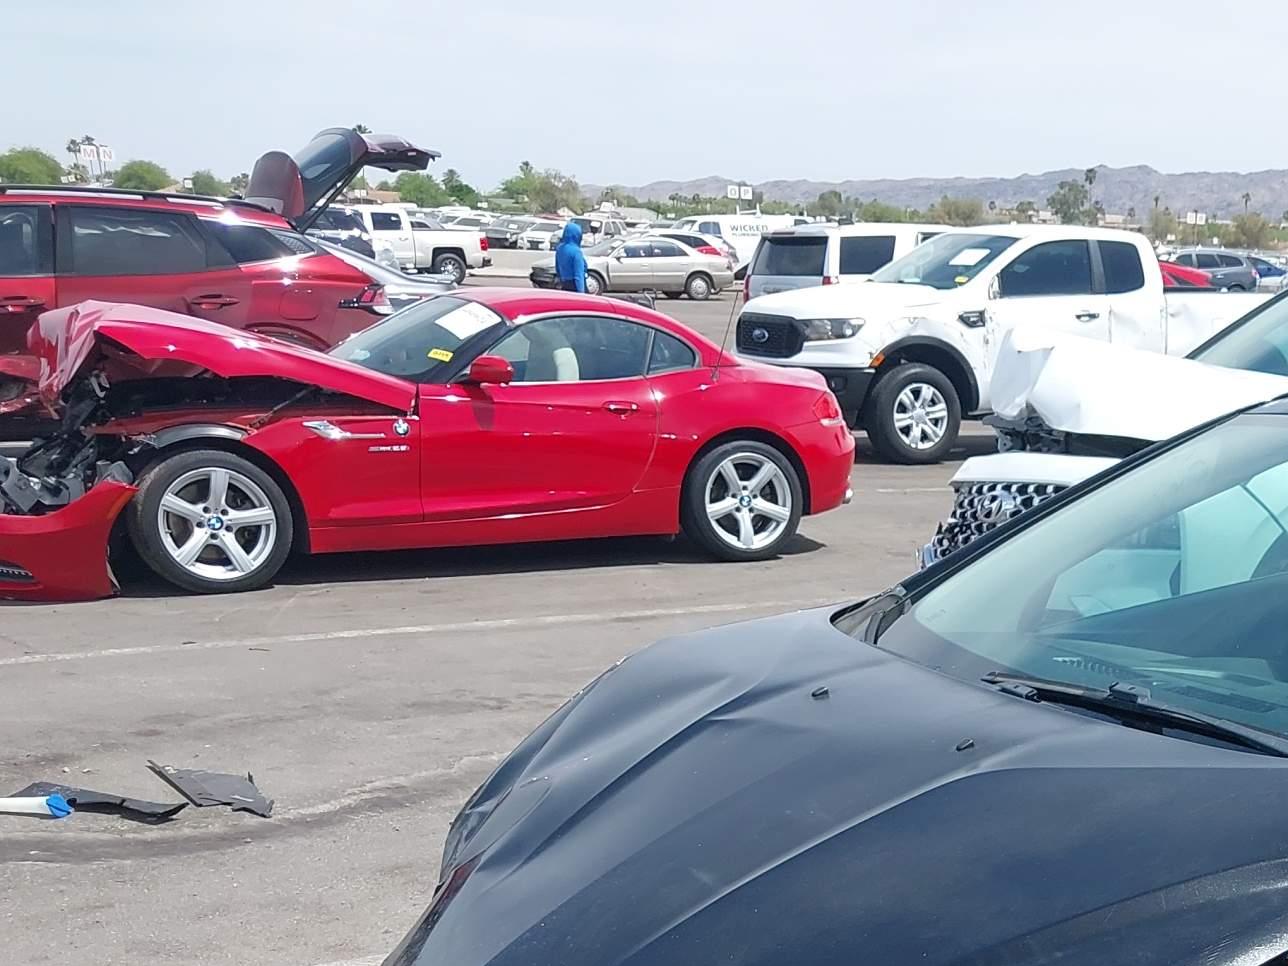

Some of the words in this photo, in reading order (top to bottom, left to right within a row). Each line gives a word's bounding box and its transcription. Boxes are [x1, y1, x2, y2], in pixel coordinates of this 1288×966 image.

[82, 148, 96, 159] M
[102, 149, 112, 160] N
[730, 224, 769, 232] WICKED
